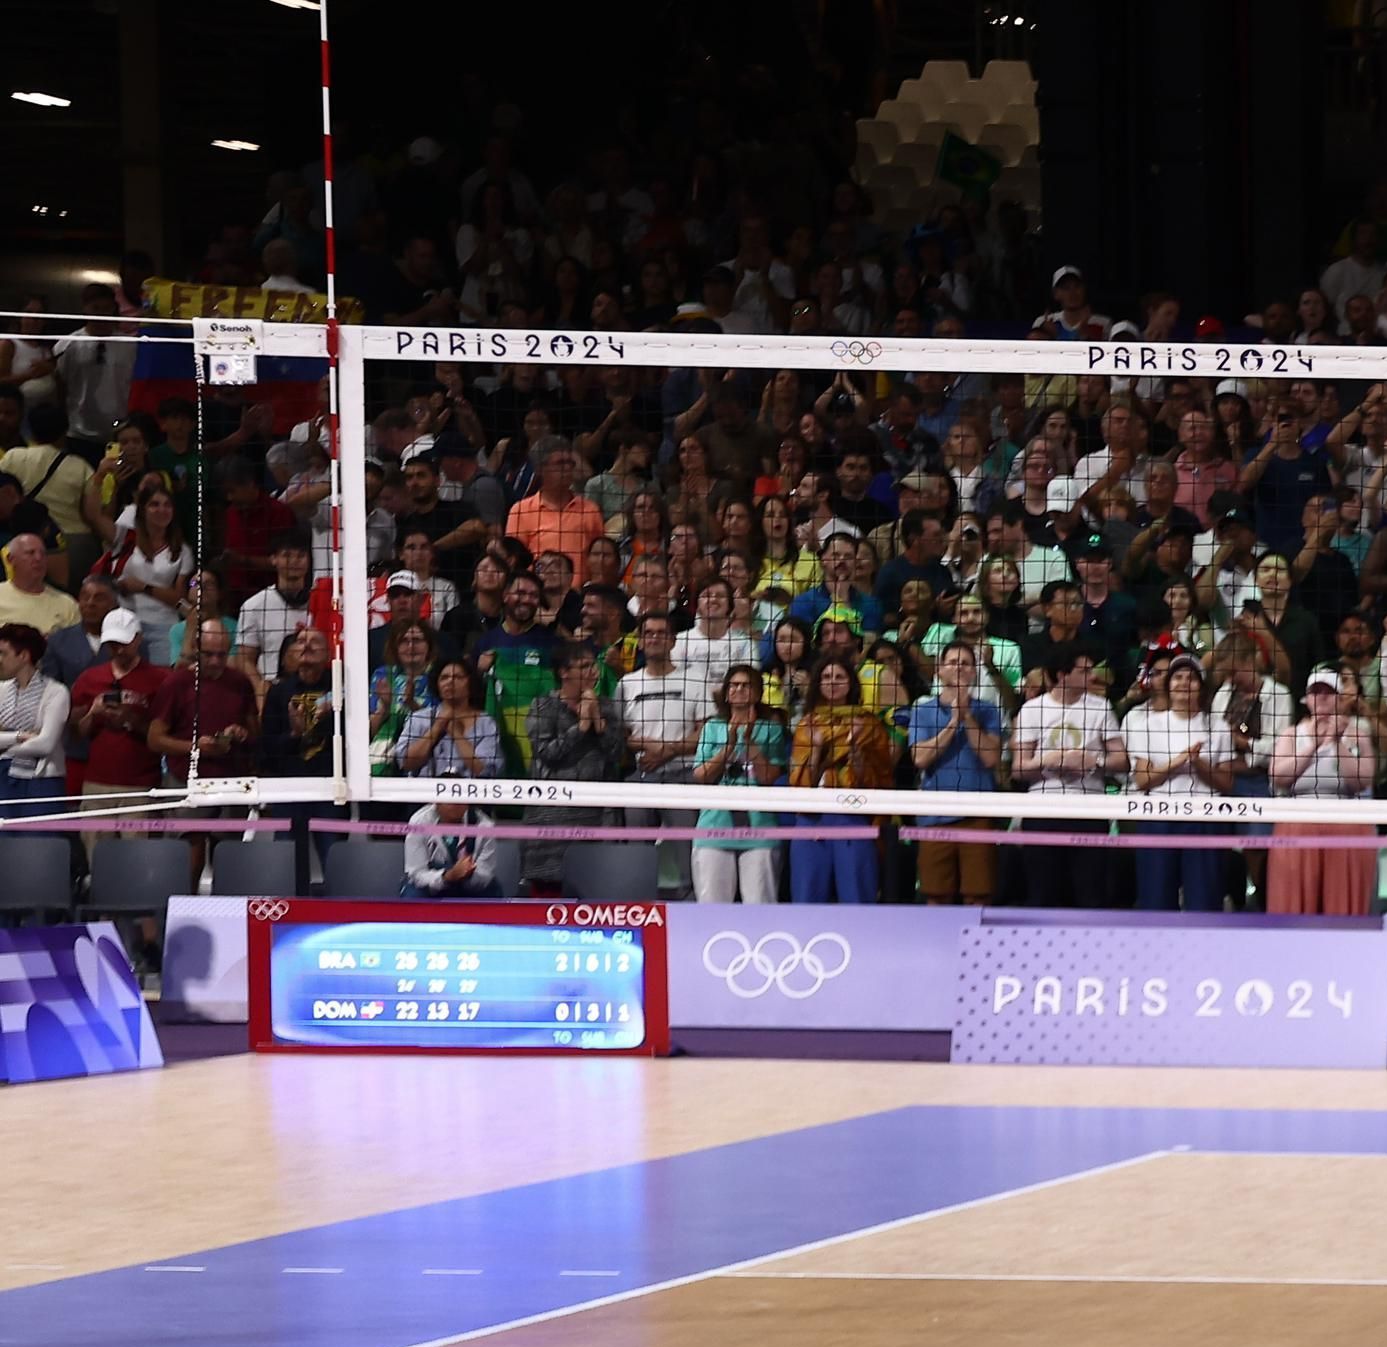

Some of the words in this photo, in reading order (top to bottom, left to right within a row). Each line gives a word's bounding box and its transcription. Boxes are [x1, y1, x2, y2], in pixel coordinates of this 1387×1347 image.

[219, 324, 252, 333] Senoh
[524, 333, 625, 359] 2024
[1215, 348, 1314, 373] 2024
[573, 904, 665, 927] OMEGA
[1194, 977, 1353, 1019] 2024
[313, 1000, 357, 1020] DOM
[395, 1001, 418, 1020] 22
[427, 1001, 449, 1020] 13
[458, 1002, 480, 1021] 17
